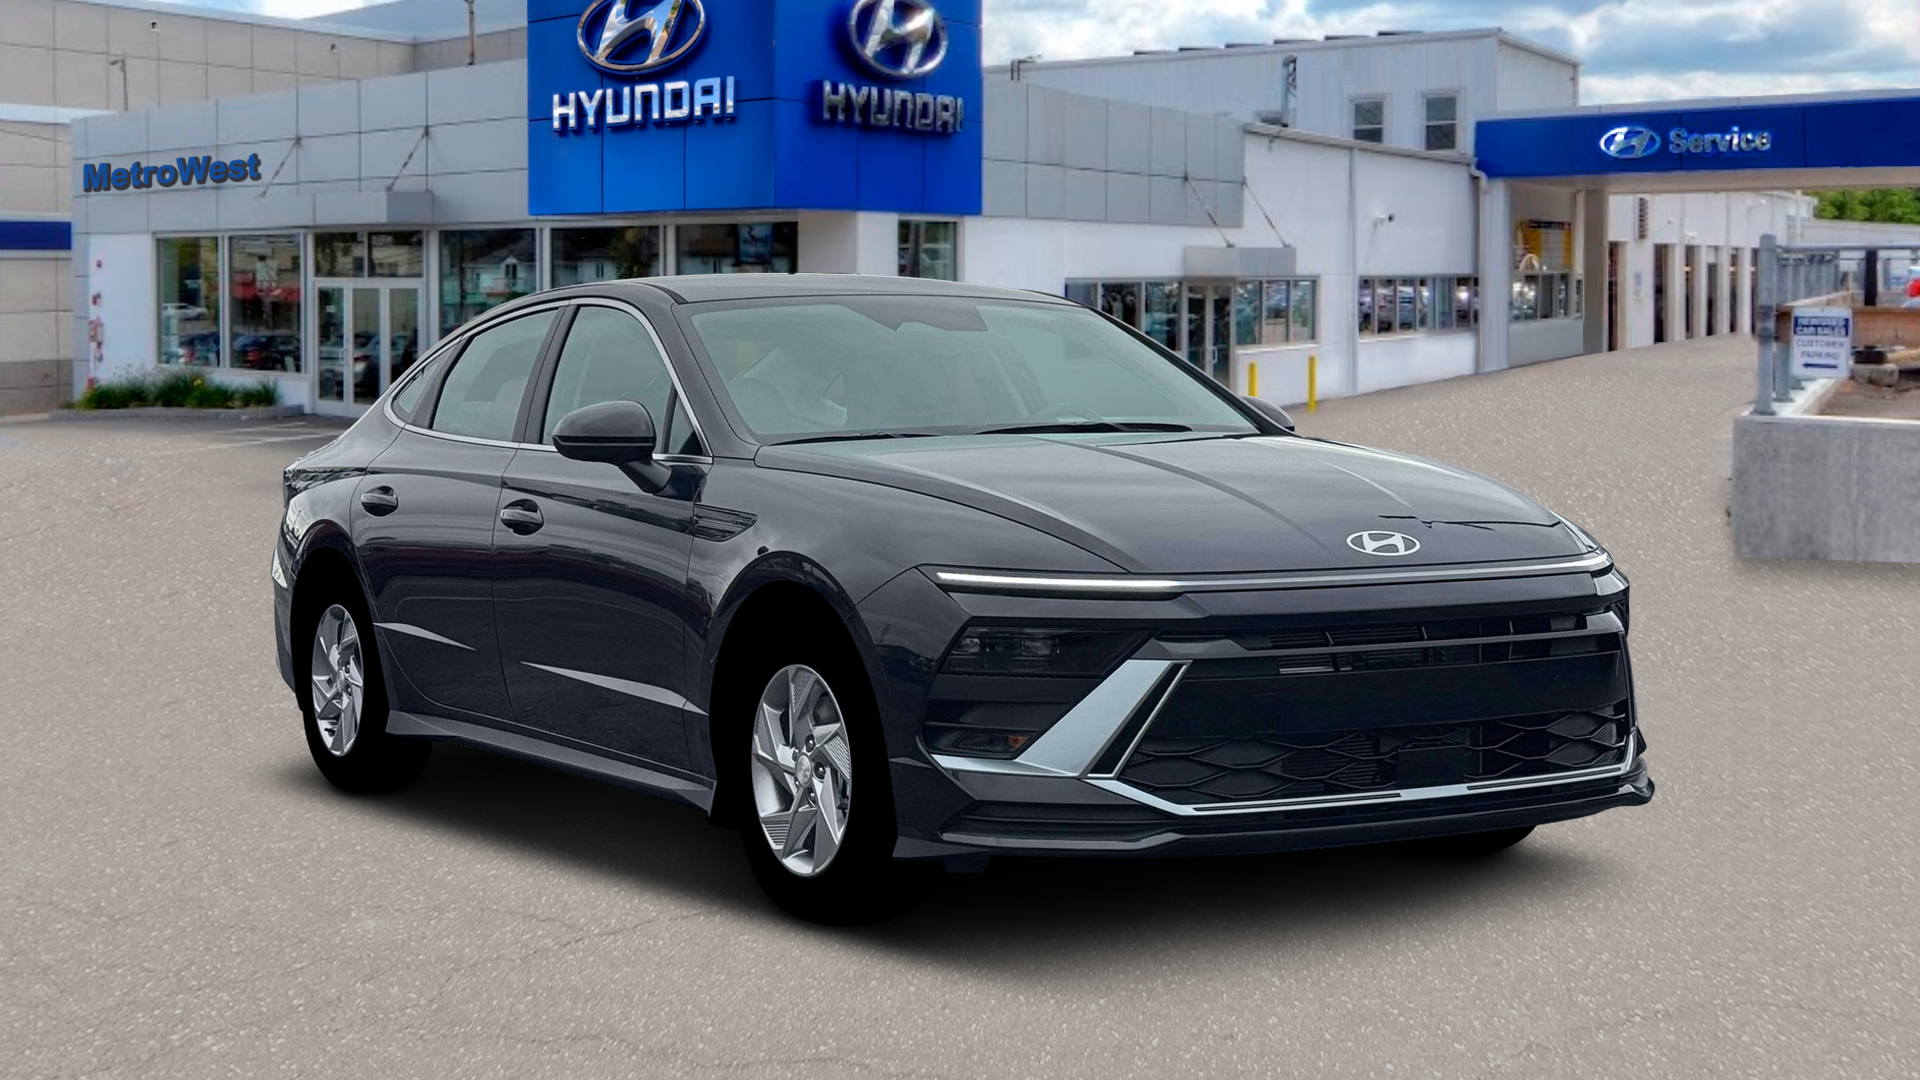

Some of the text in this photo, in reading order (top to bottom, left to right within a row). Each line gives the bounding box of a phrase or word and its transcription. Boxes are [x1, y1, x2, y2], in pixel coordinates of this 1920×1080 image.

[552, 76, 735, 132] HYUNDAI
[822, 80, 964, 133] HYUNDAI
[1669, 126, 1772, 154] Service
[83, 153, 261, 192] MetroWest
